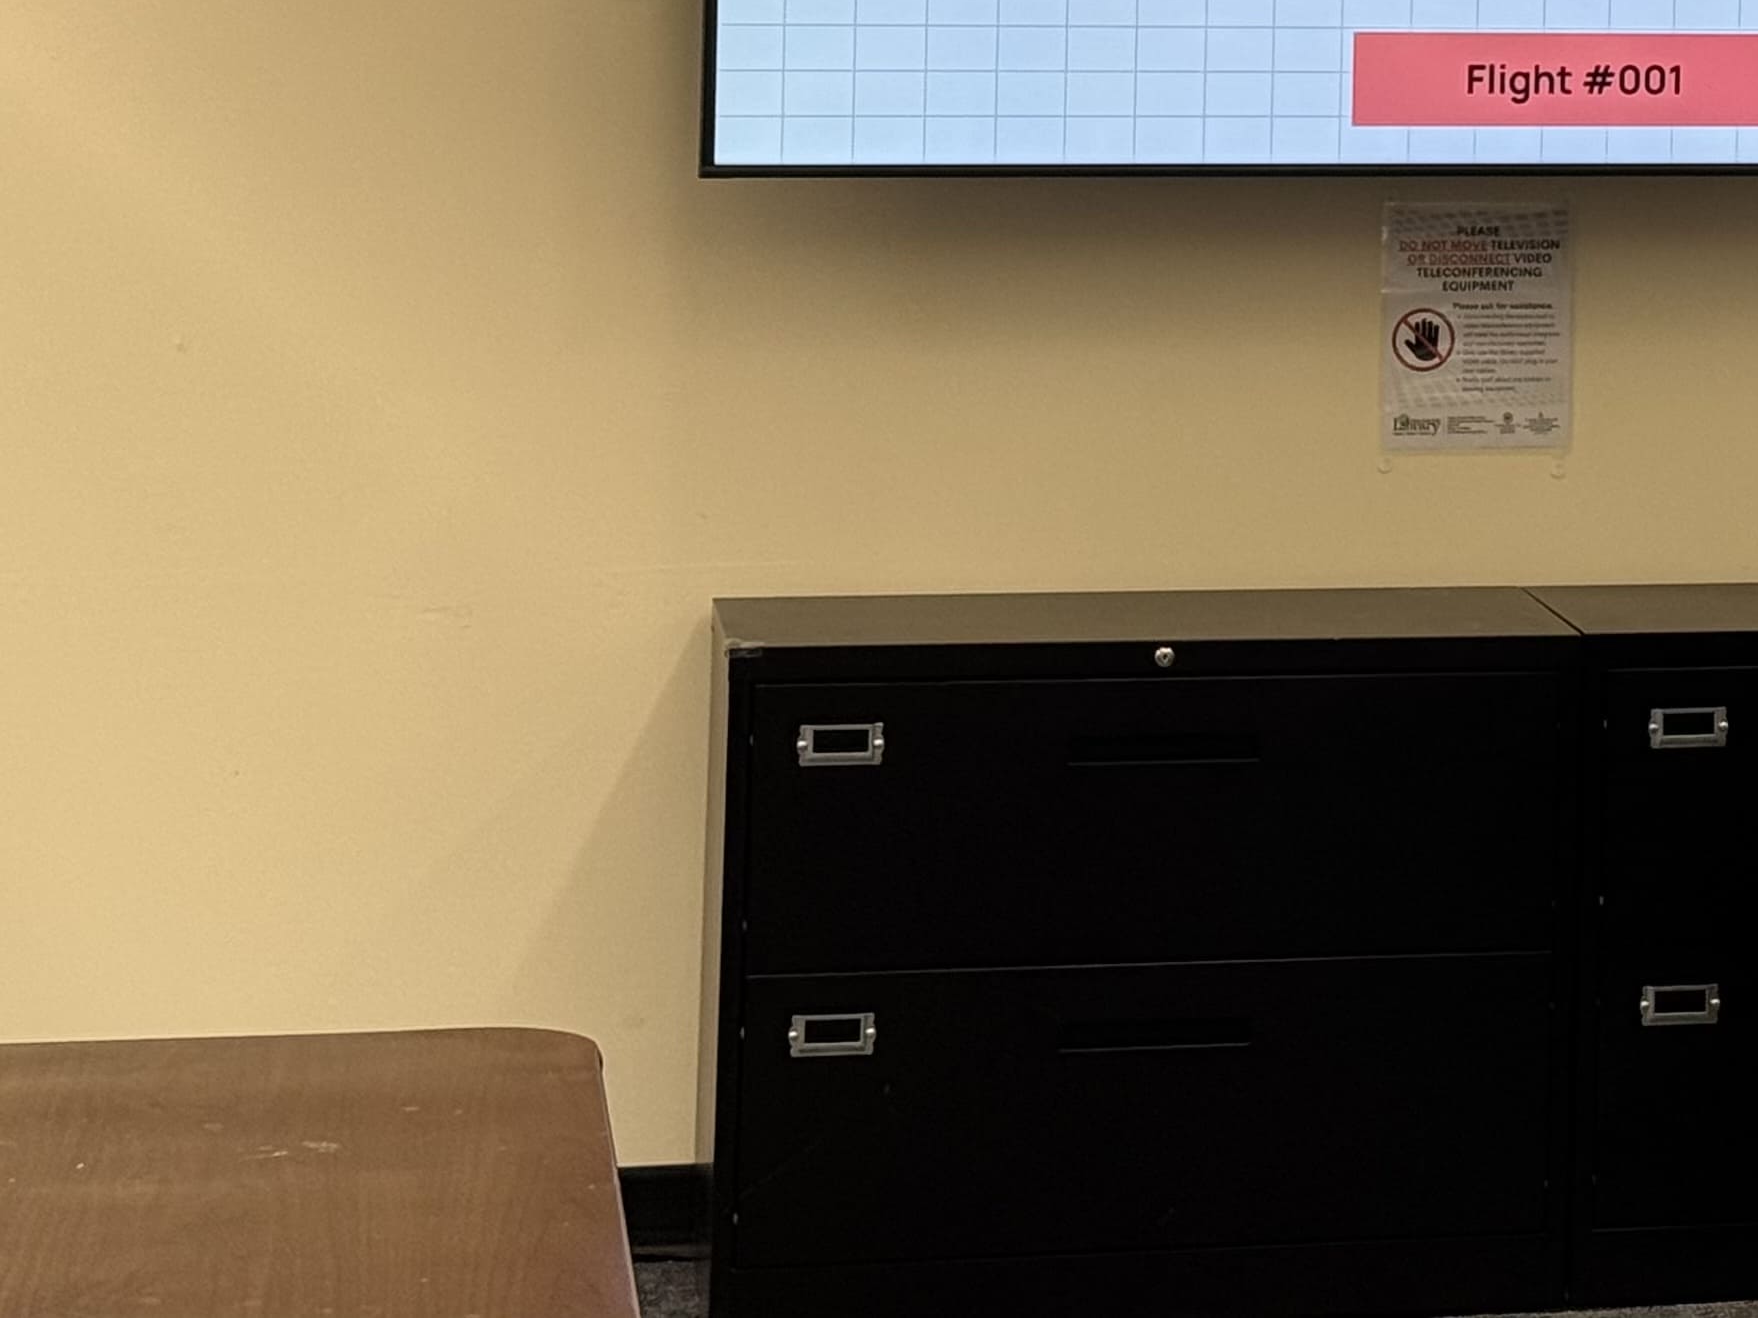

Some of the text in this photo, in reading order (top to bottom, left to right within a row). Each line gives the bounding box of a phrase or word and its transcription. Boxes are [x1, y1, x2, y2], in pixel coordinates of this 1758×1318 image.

[1467, 64, 1683, 104] Flight #001
[1457, 226, 1500, 237] PLEASE
[1400, 239, 1560, 251] DO NOT MOVE TELEVISION
[1407, 253, 1552, 265] OR DISCONNECT VIDEO
[1416, 267, 1543, 278] TELECONFERENCING
[1442, 281, 1514, 292] EQUIPMENT
